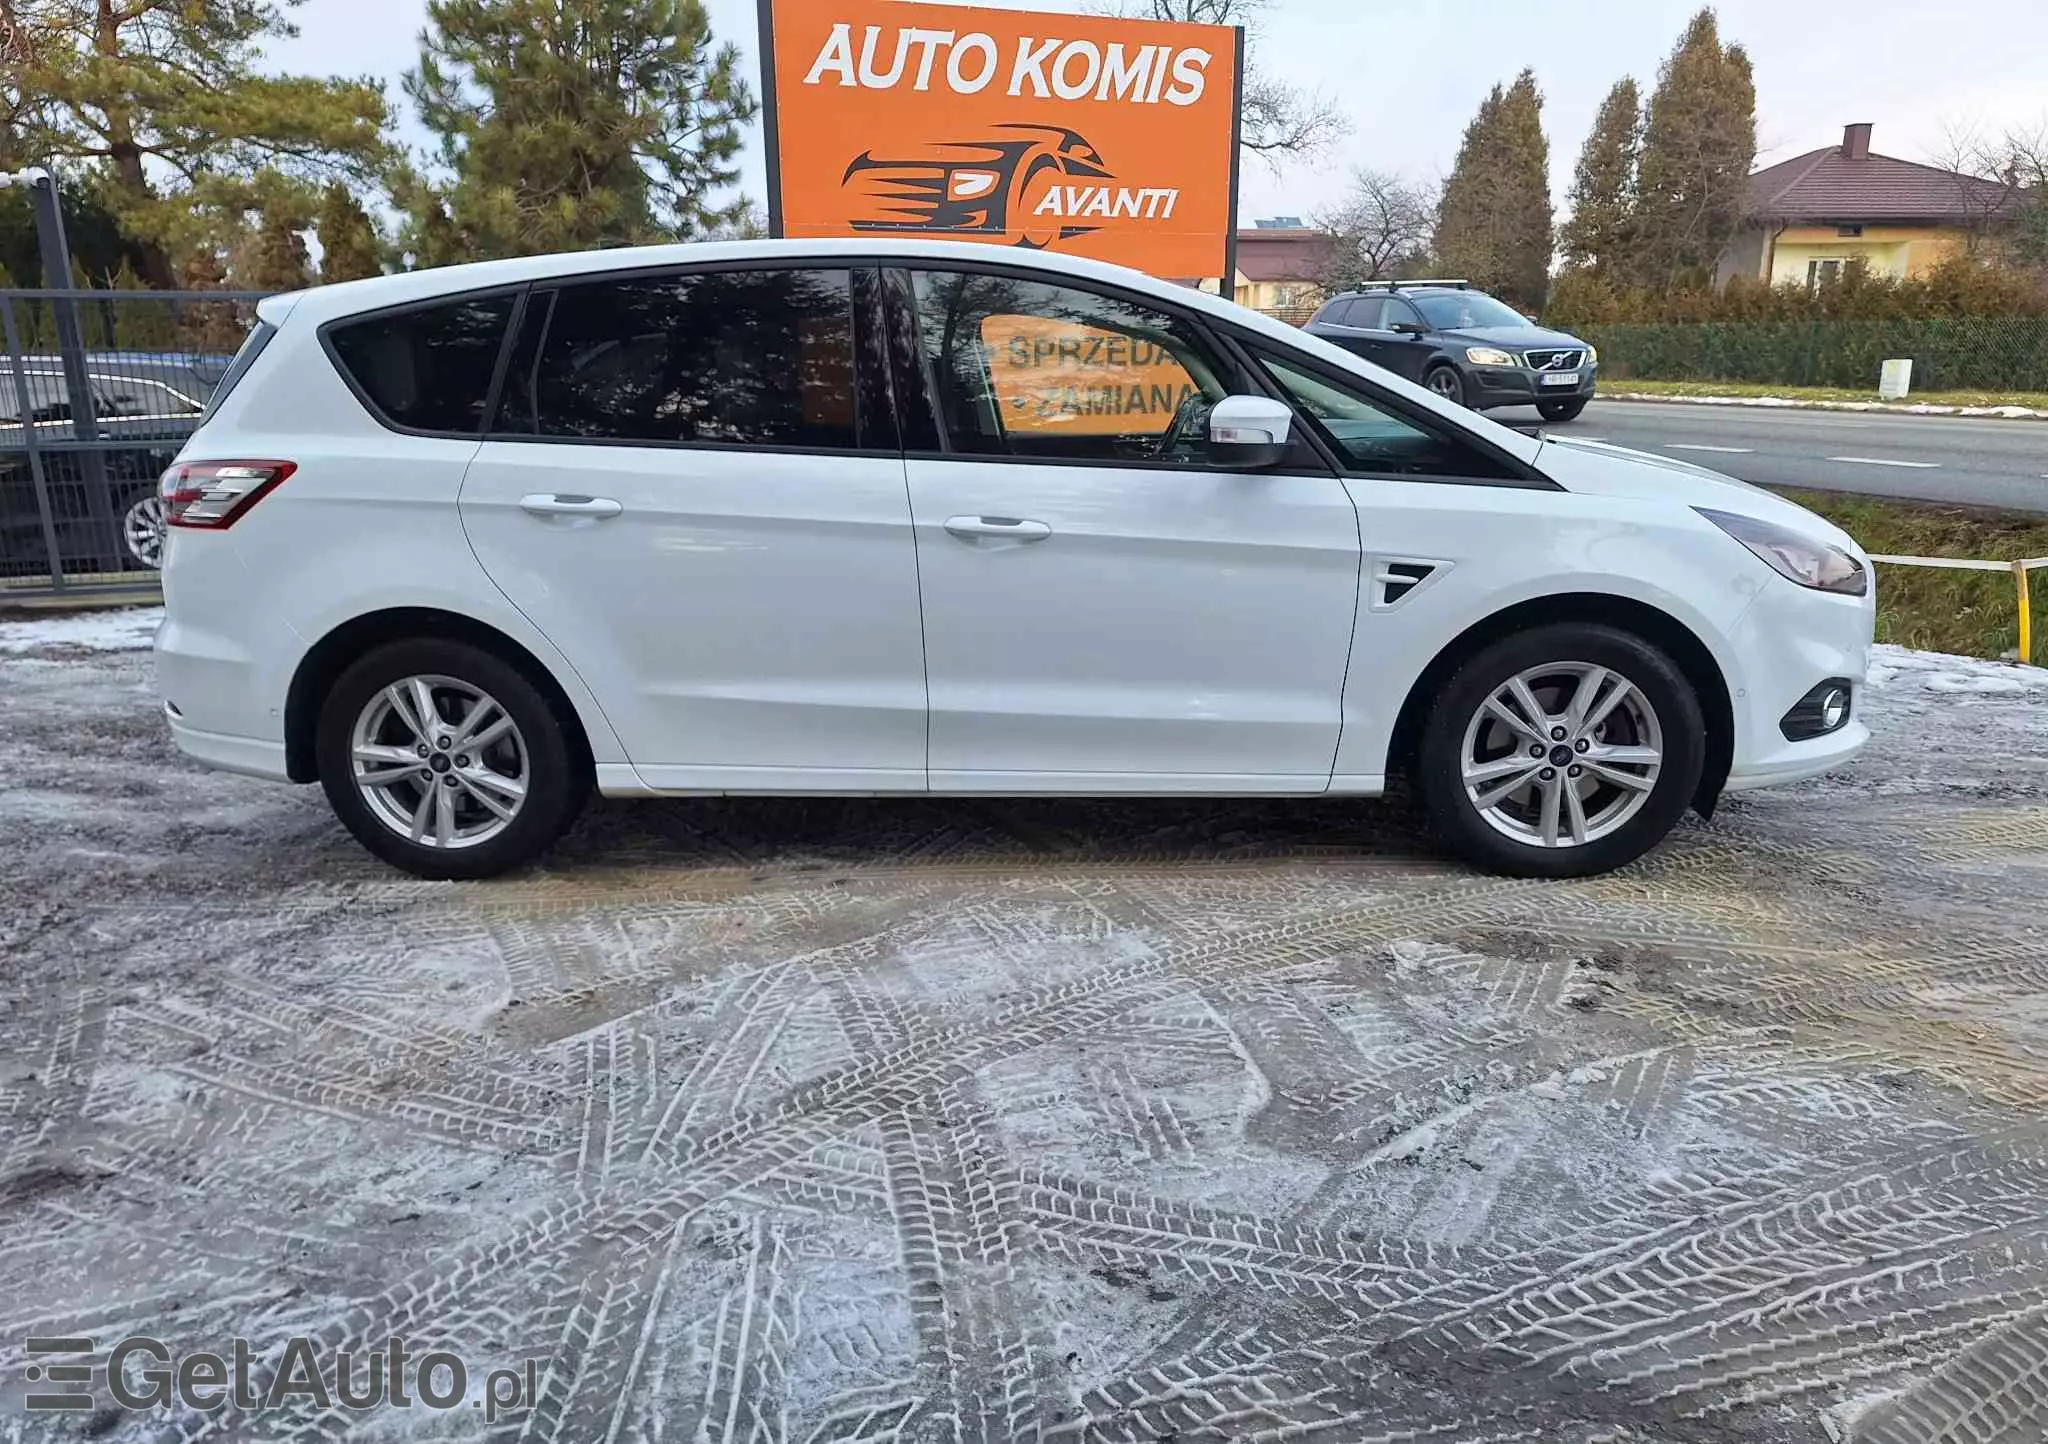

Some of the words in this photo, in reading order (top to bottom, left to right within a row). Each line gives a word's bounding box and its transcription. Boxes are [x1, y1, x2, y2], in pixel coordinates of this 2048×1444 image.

[803, 23, 999, 95] AUTO
[1006, 36, 1213, 106] KOMIS
[1032, 185, 1181, 220] AVANTI
